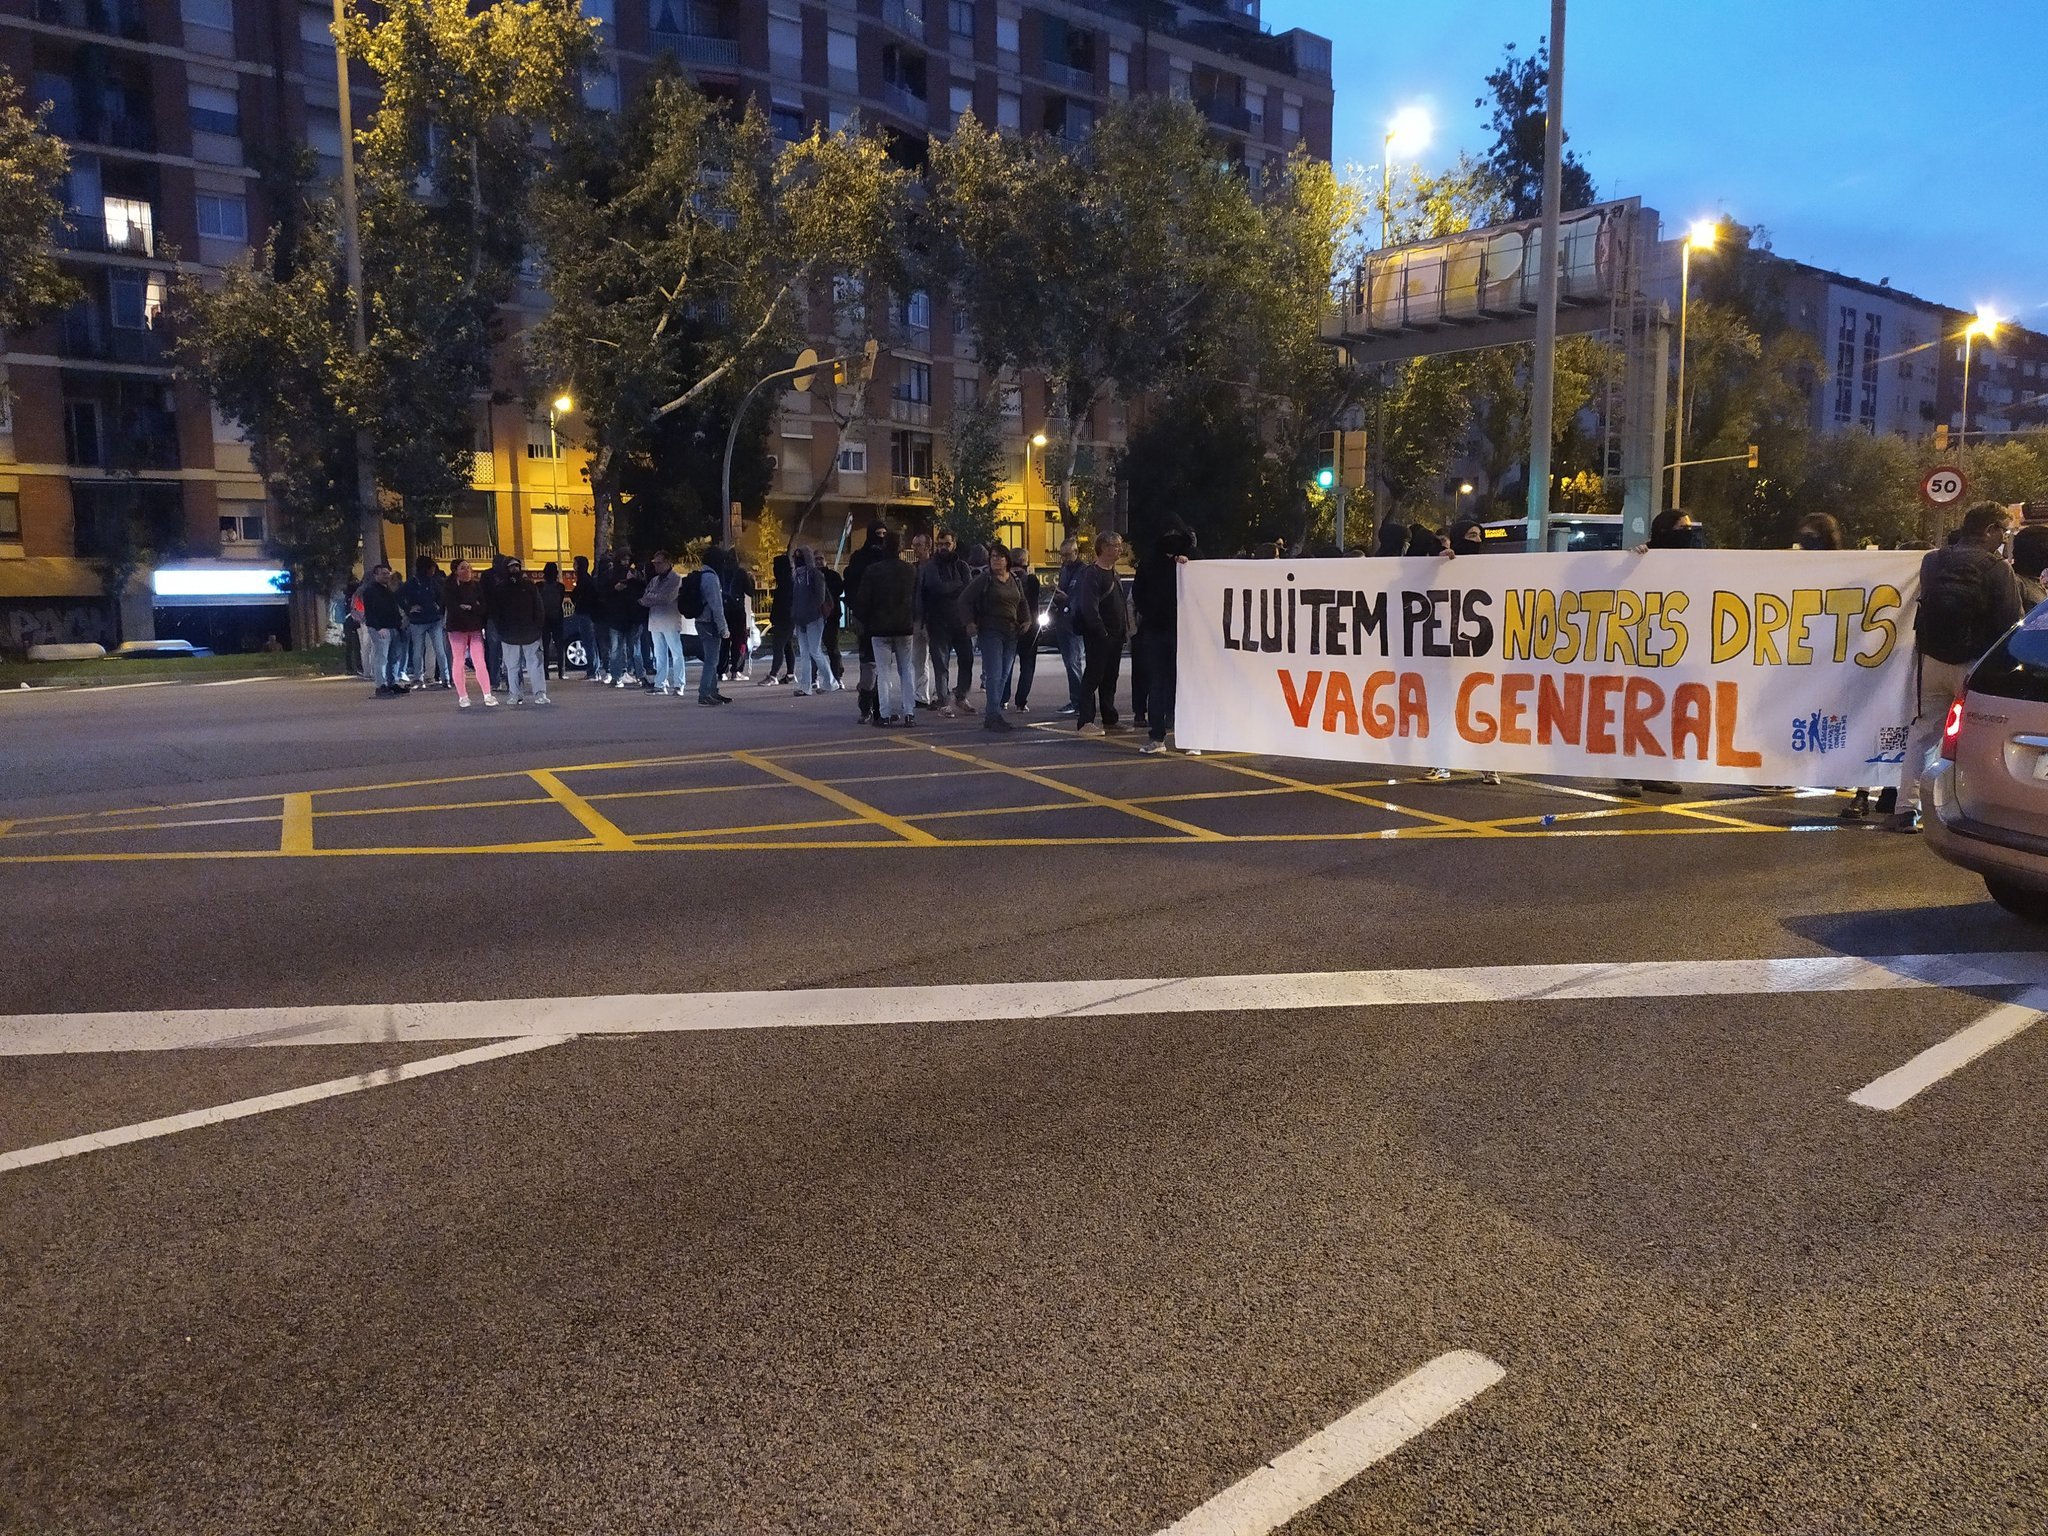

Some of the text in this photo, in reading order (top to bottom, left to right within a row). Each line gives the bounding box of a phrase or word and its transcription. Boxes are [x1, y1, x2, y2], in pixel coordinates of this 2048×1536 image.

[1931, 479, 1957, 494] 50
[1401, 588, 1494, 658] PELS
[1502, 588, 1690, 669] NOSTRES
[1710, 584, 1902, 669] DRETS
[1277, 669, 1430, 740] VAGA
[1454, 671, 1763, 769] GENERAL
[1791, 717, 1807, 752] CDR
